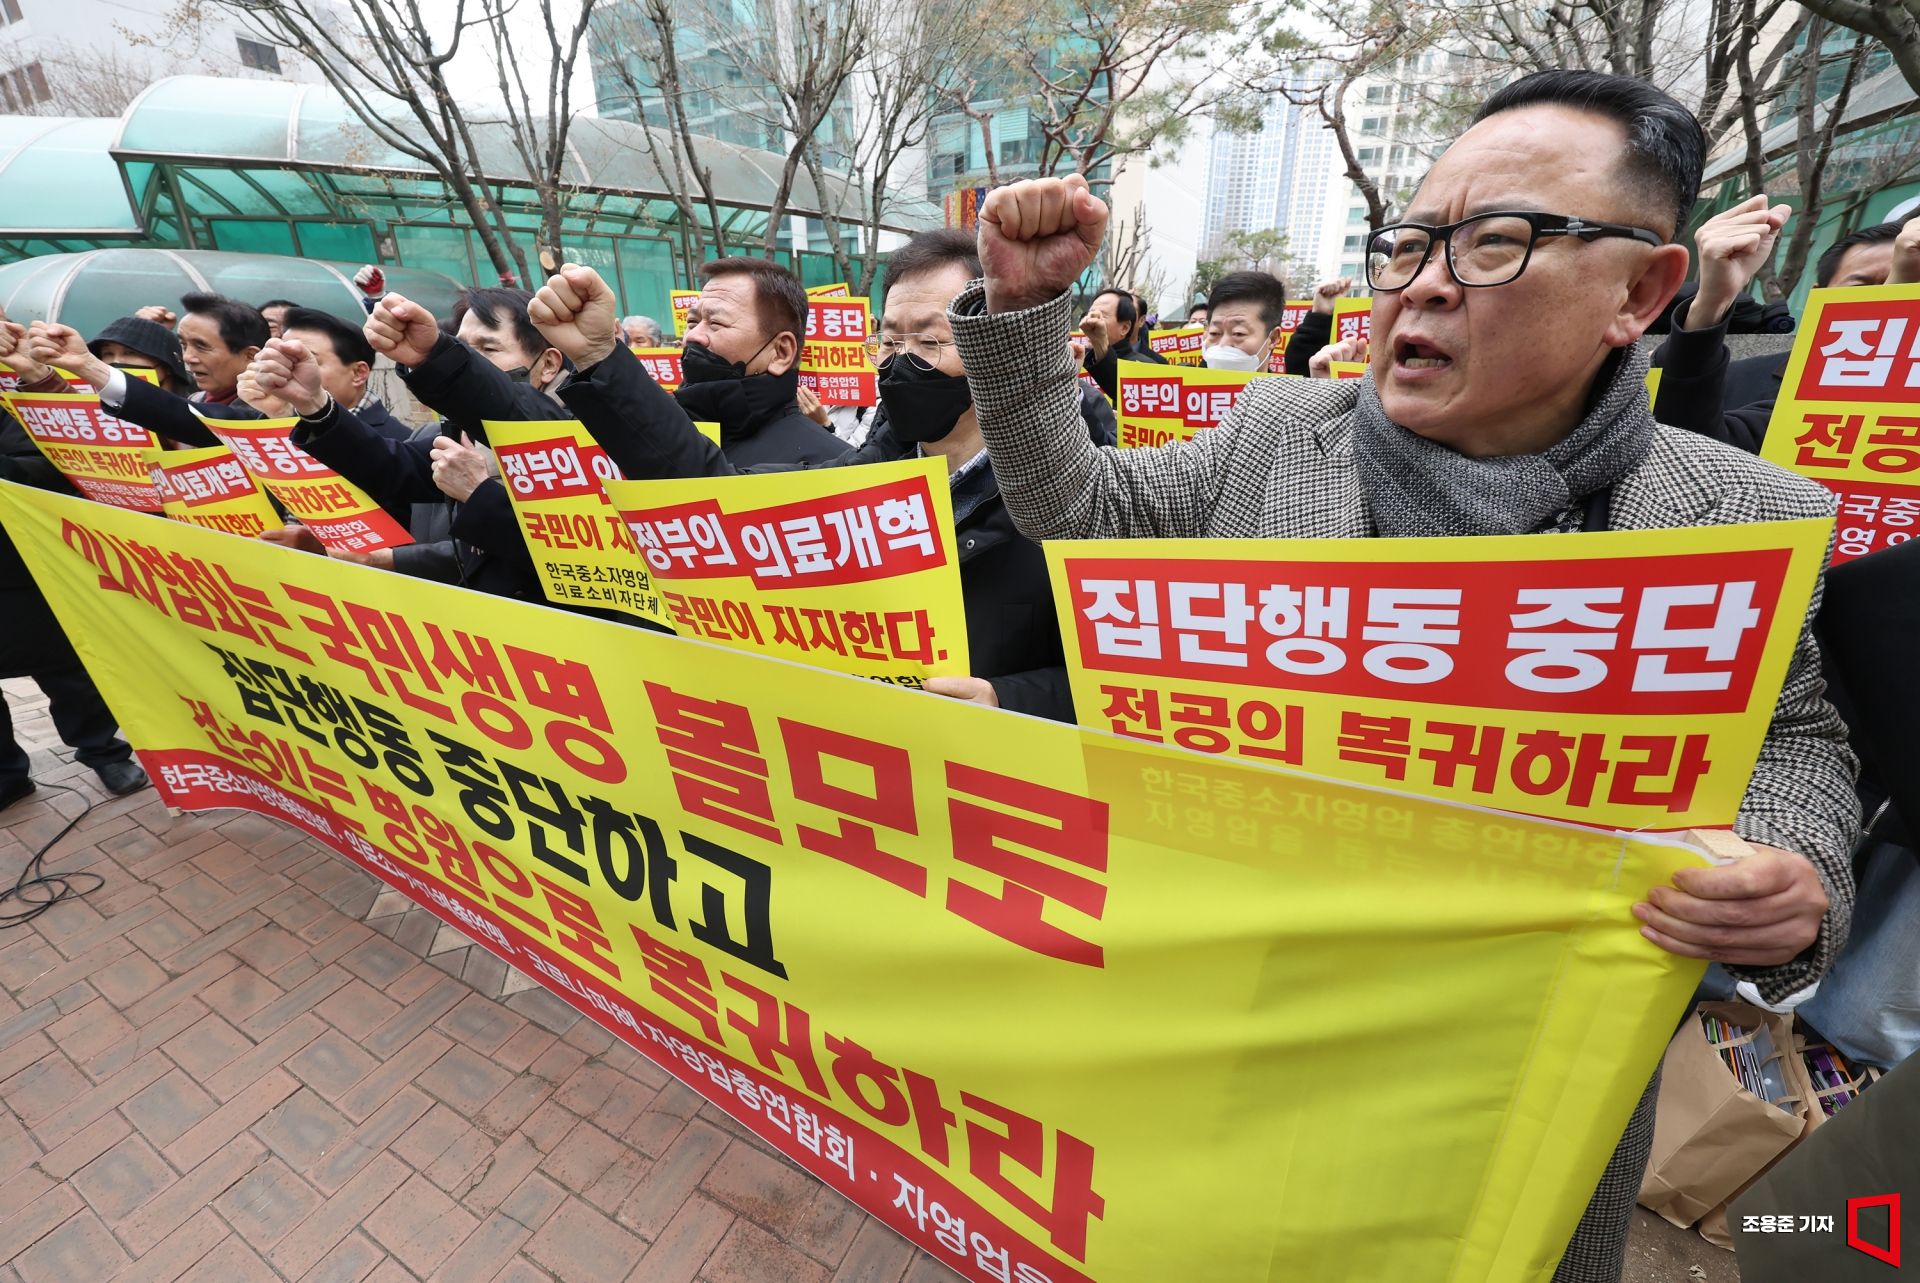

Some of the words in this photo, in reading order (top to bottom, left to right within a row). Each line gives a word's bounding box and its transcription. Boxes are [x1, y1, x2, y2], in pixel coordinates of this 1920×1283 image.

[823, 309, 864, 337] 중단
[1152, 337, 1177, 352] 정부의
[1180, 334, 1203, 350] 의료
[16, 406, 97, 440] 집단행동
[1123, 384, 1180, 413] 정부의
[1187, 392, 1243, 422] 의료
[1794, 413, 1920, 474] 전공
[171, 460, 252, 500] 의료개혁
[500, 446, 589, 494] 정부의
[522, 511, 605, 551] 국민이
[628, 511, 738, 571] 정부의
[740, 493, 936, 578] 의료개혁
[545, 561, 650, 591] 한국중소자영업
[555, 583, 659, 615] 의료소비자단체
[664, 591, 765, 646] 국민이
[762, 604, 948, 665] 지지한다.
[1079, 578, 1462, 685] 집단행동
[1504, 580, 1758, 694] 중단
[1099, 684, 1305, 766] 전공의
[1337, 711, 1712, 813] 복귀하라
[279, 582, 627, 784] 국민생명
[643, 680, 1109, 968] 볼모로
[200, 640, 434, 797] 집단행동
[424, 727, 789, 981] 중단하고
[358, 775, 622, 982] 병원으로
[628, 923, 1106, 1264] 복귀하라
